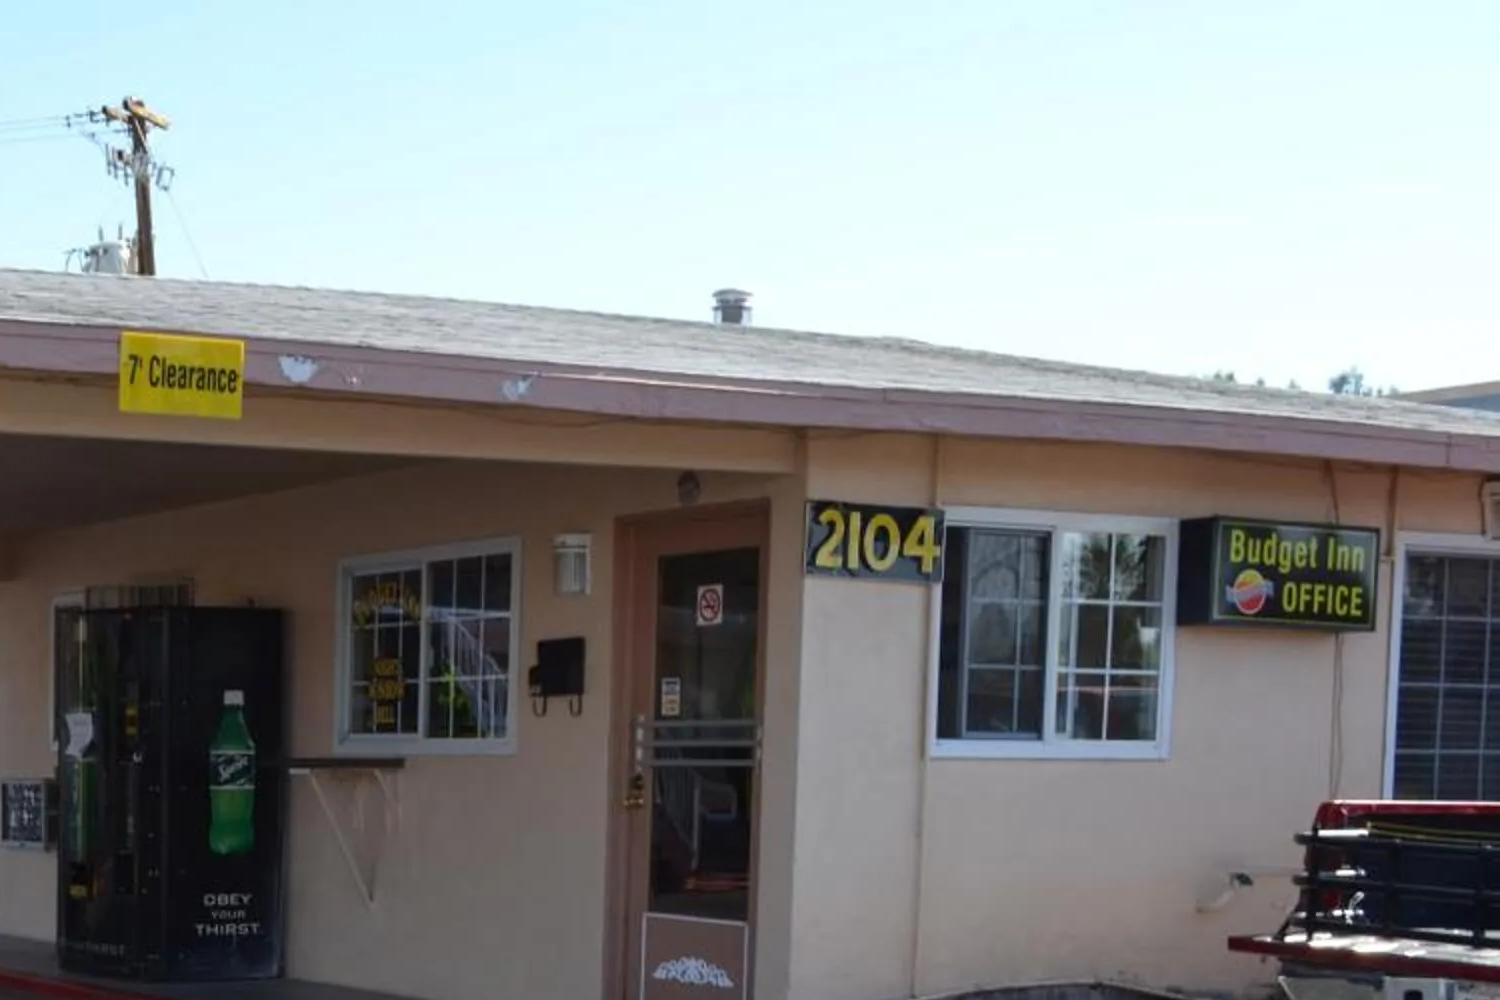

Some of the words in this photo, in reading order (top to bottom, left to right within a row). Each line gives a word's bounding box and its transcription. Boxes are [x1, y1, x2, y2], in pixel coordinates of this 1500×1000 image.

[148, 355, 238, 394] Clearance
[815, 509, 941, 573] 2104
[1230, 529, 1319, 574] Budget
[1327, 536, 1366, 573] Inn
[1282, 581, 1363, 617] OFFICE
[203, 893, 252, 907] OBEY
[211, 909, 246, 920] YOUR
[195, 923, 260, 937] THIRST
